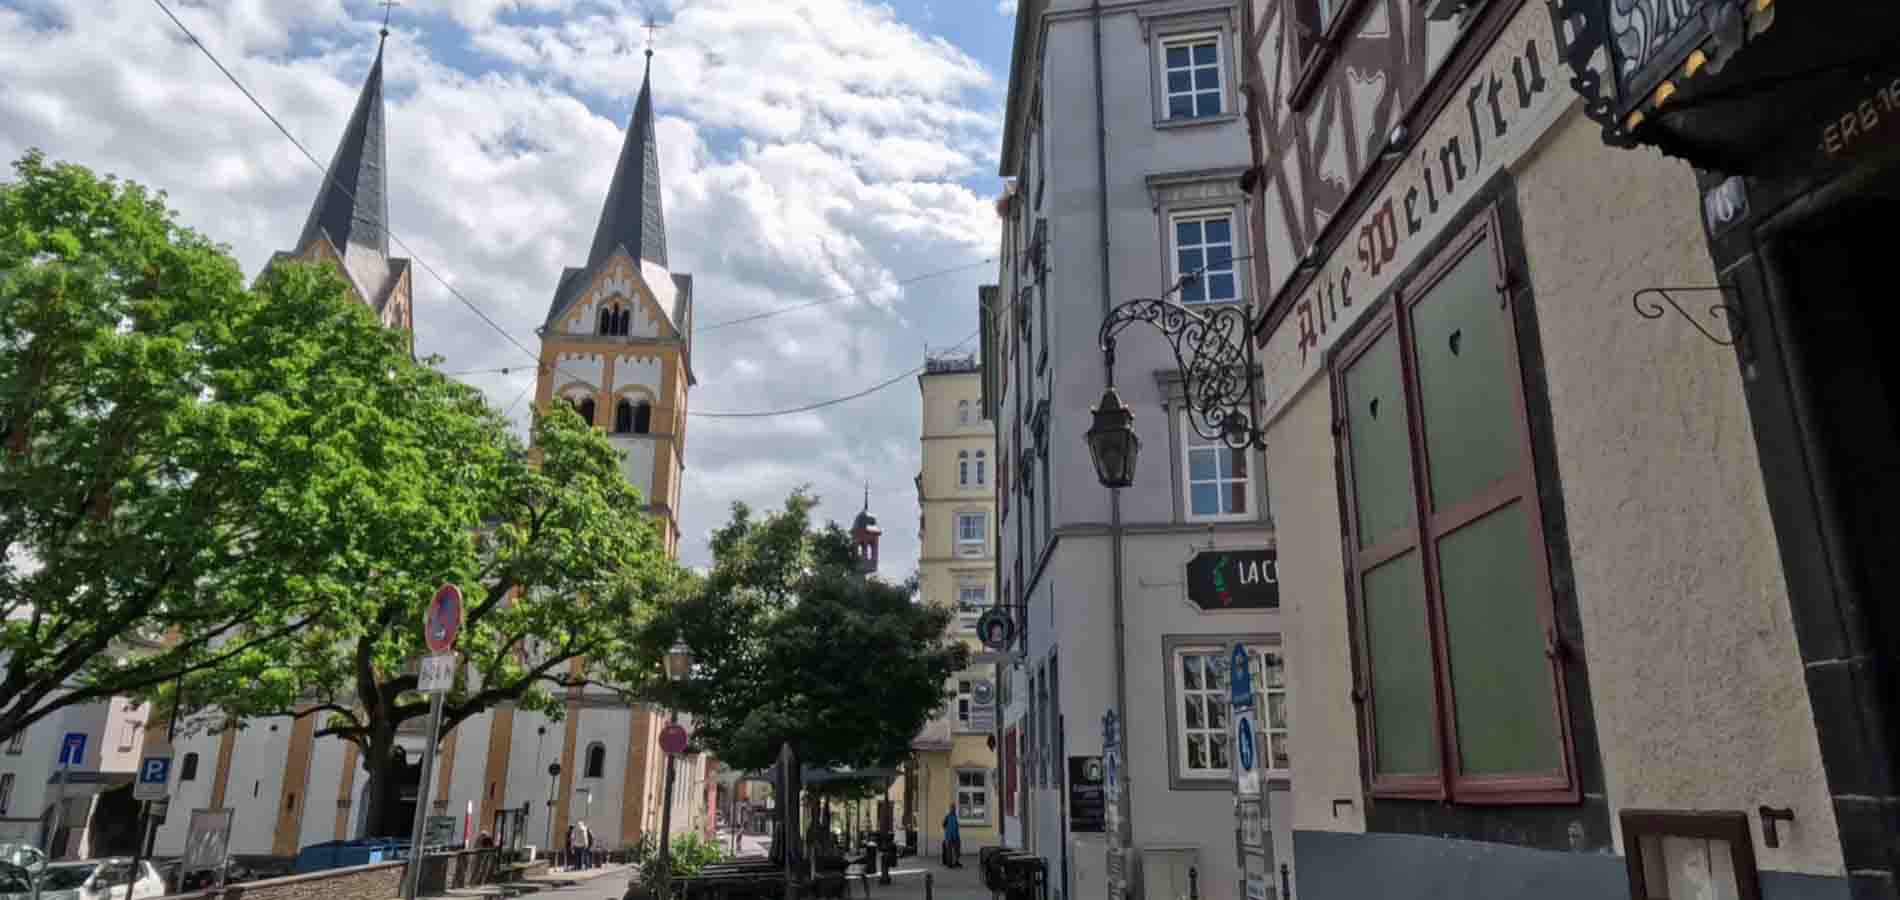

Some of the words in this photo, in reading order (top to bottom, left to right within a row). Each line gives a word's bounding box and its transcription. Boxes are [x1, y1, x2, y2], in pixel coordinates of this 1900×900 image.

[1297, 265, 1353, 368] Alte
[1239, 560, 1259, 585] LA
[145, 759, 164, 781] P
